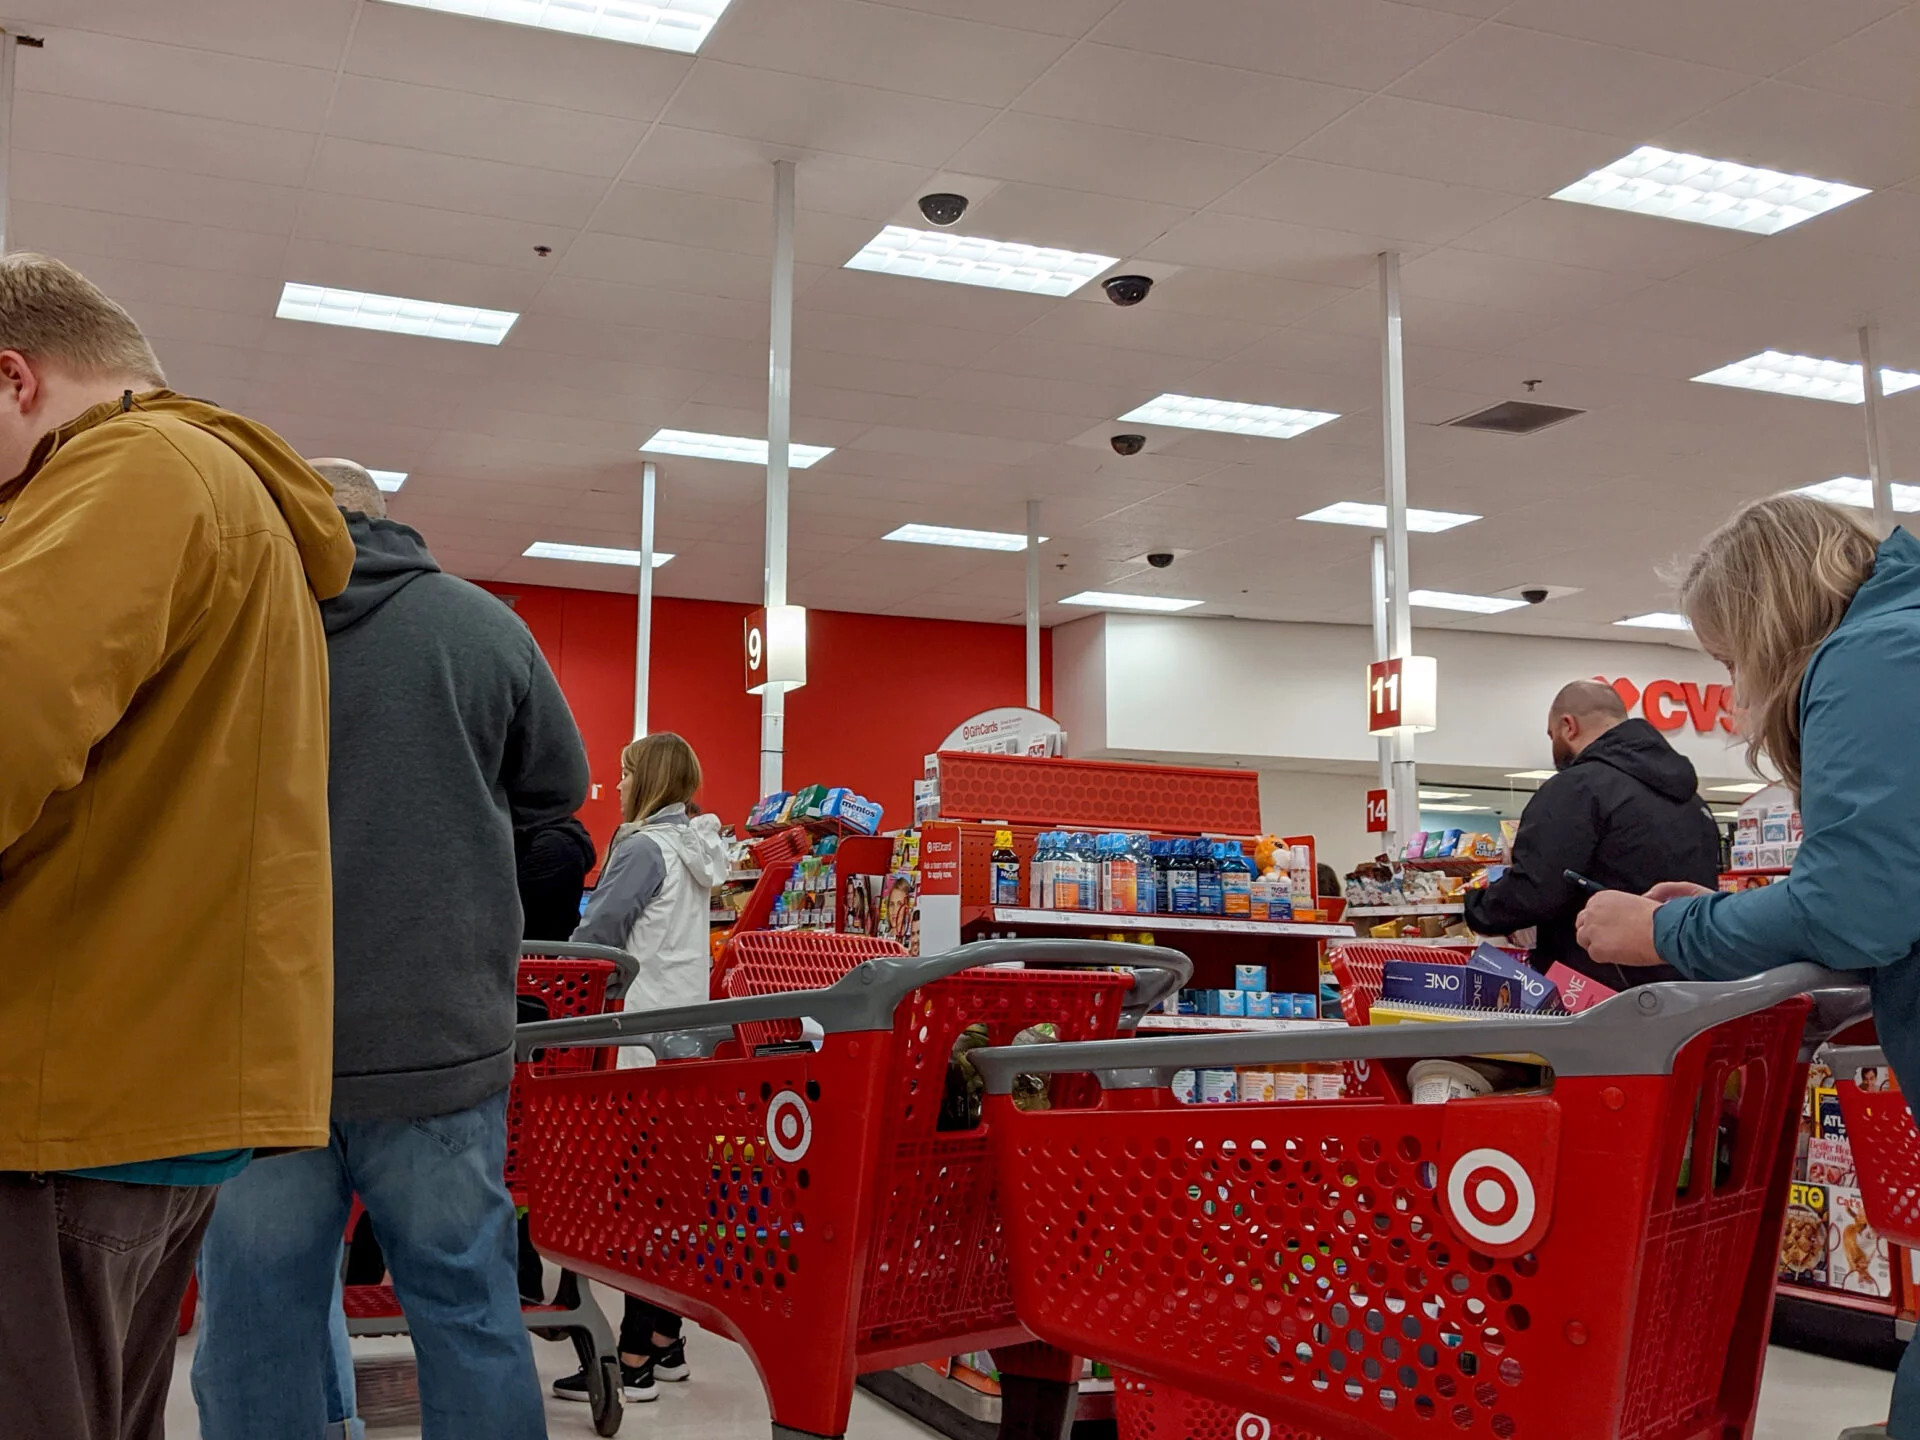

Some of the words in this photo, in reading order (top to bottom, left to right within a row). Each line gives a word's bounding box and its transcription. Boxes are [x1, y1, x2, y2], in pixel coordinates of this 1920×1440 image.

[748, 627, 762, 671] 9
[1371, 673, 1399, 714] 11
[969, 721, 998, 738] GiftCards
[841, 800, 876, 818] mentos
[1367, 799, 1387, 823] 14
[1424, 972, 1460, 991] ONE
[1473, 973, 1483, 1010] ONE
[1513, 969, 1545, 996] ONE
[1561, 975, 1586, 1008] ONE
[1824, 1133, 1848, 1142] SPA
[1836, 1196, 1861, 1208] Cat's
